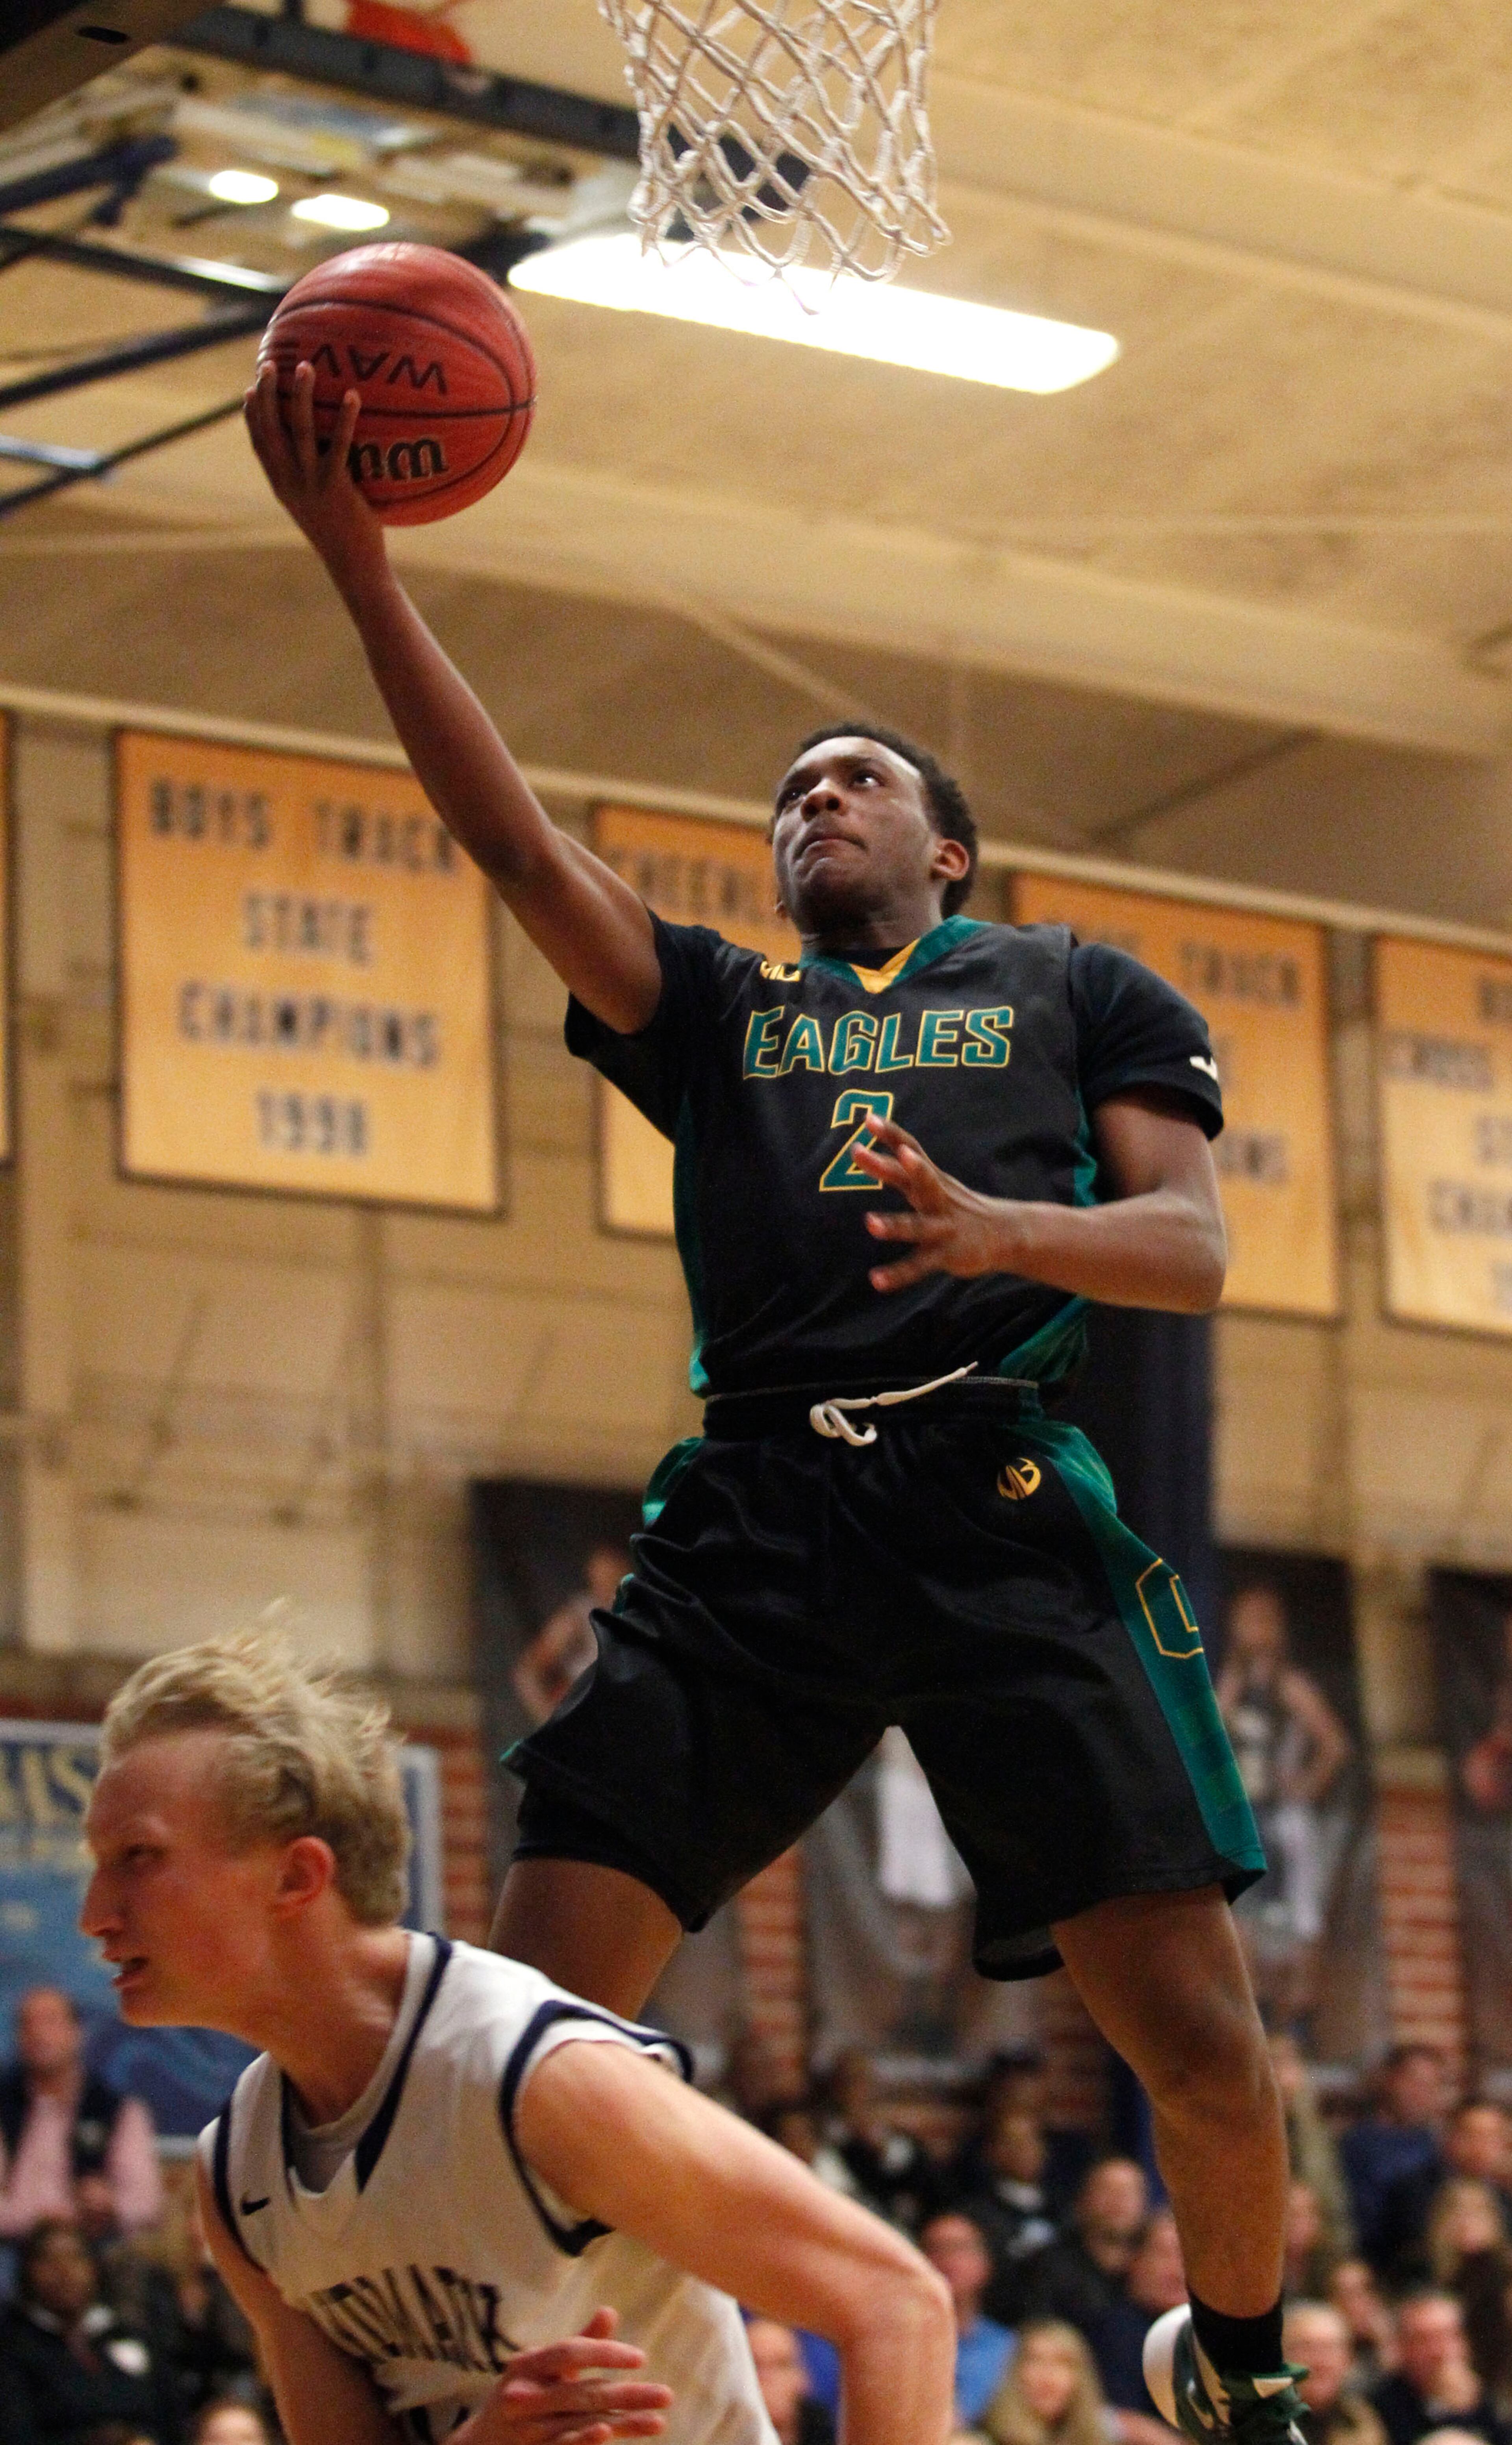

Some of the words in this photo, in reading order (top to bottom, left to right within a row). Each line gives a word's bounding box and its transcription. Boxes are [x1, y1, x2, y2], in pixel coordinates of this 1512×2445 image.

[246, 890, 373, 968] STATE
[742, 1005, 1014, 1080] EAGLES
[819, 1088, 894, 1192] 2
